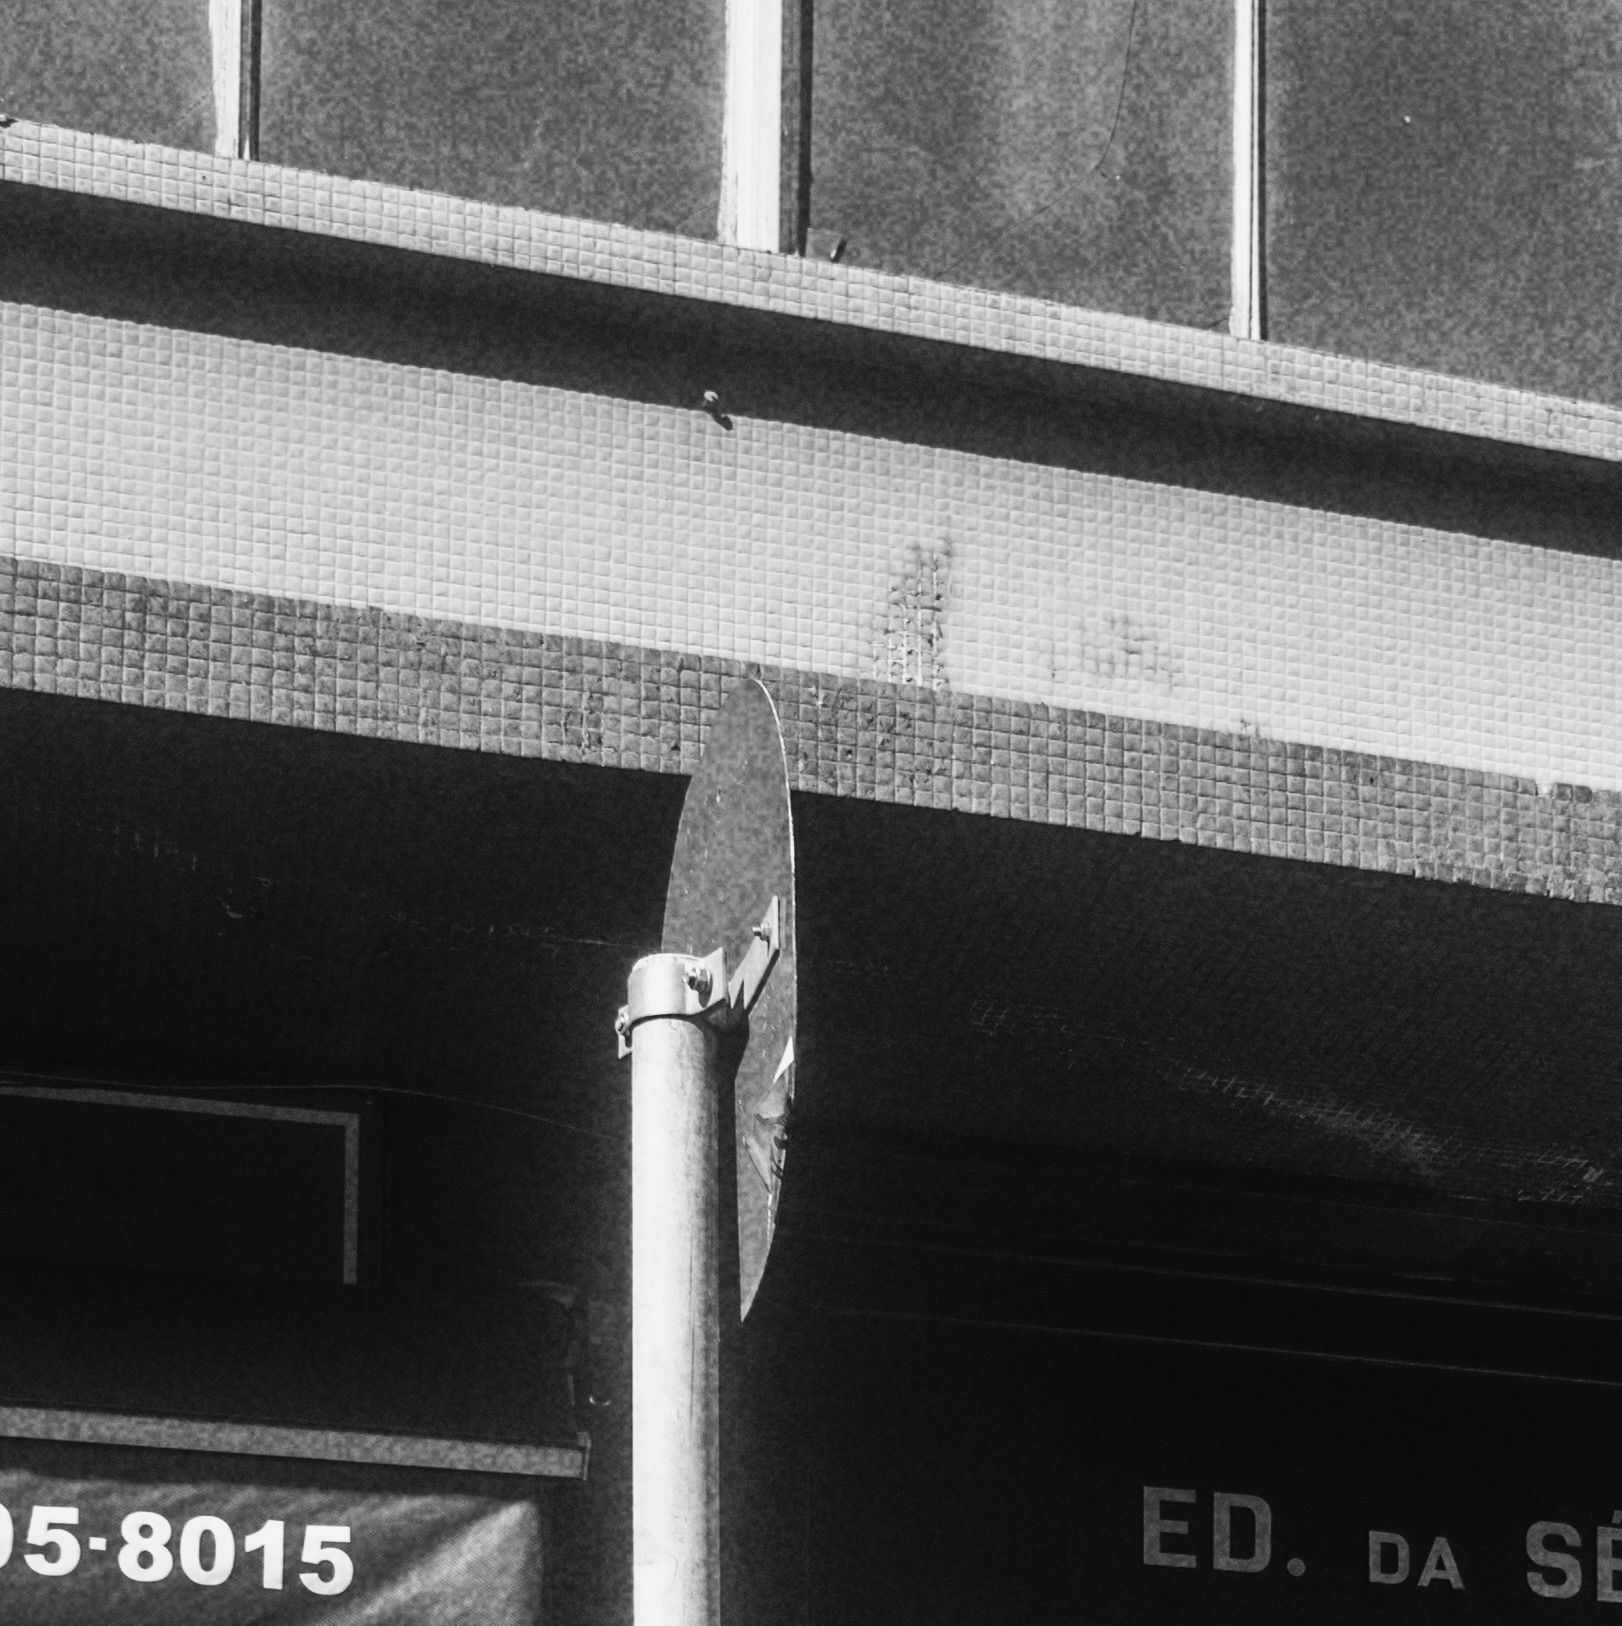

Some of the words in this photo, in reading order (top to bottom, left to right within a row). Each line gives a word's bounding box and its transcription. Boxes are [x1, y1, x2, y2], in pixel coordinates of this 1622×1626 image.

[0, 1503, 354, 1596] 5-8015
[1142, 1486, 1307, 1577] ED.
[1368, 1530, 1466, 1590] DA
